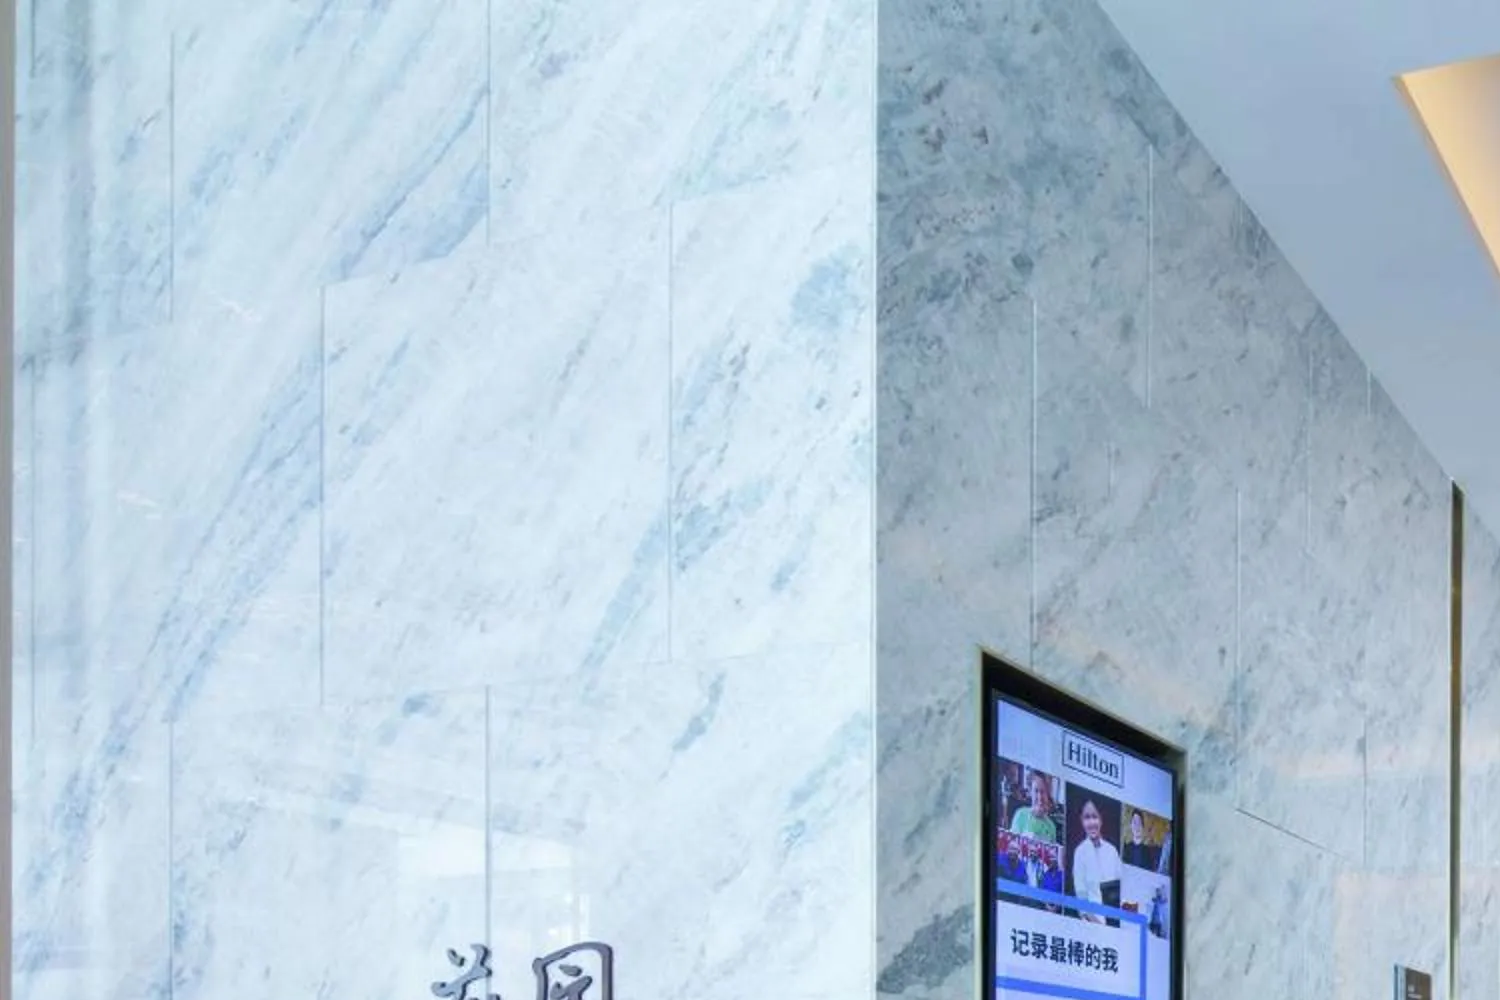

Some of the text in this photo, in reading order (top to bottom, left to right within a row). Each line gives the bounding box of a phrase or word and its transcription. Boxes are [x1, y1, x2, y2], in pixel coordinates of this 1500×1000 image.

[1069, 740, 1119, 779] Hilton
[1010, 927, 1119, 974] 记录最棒的我
